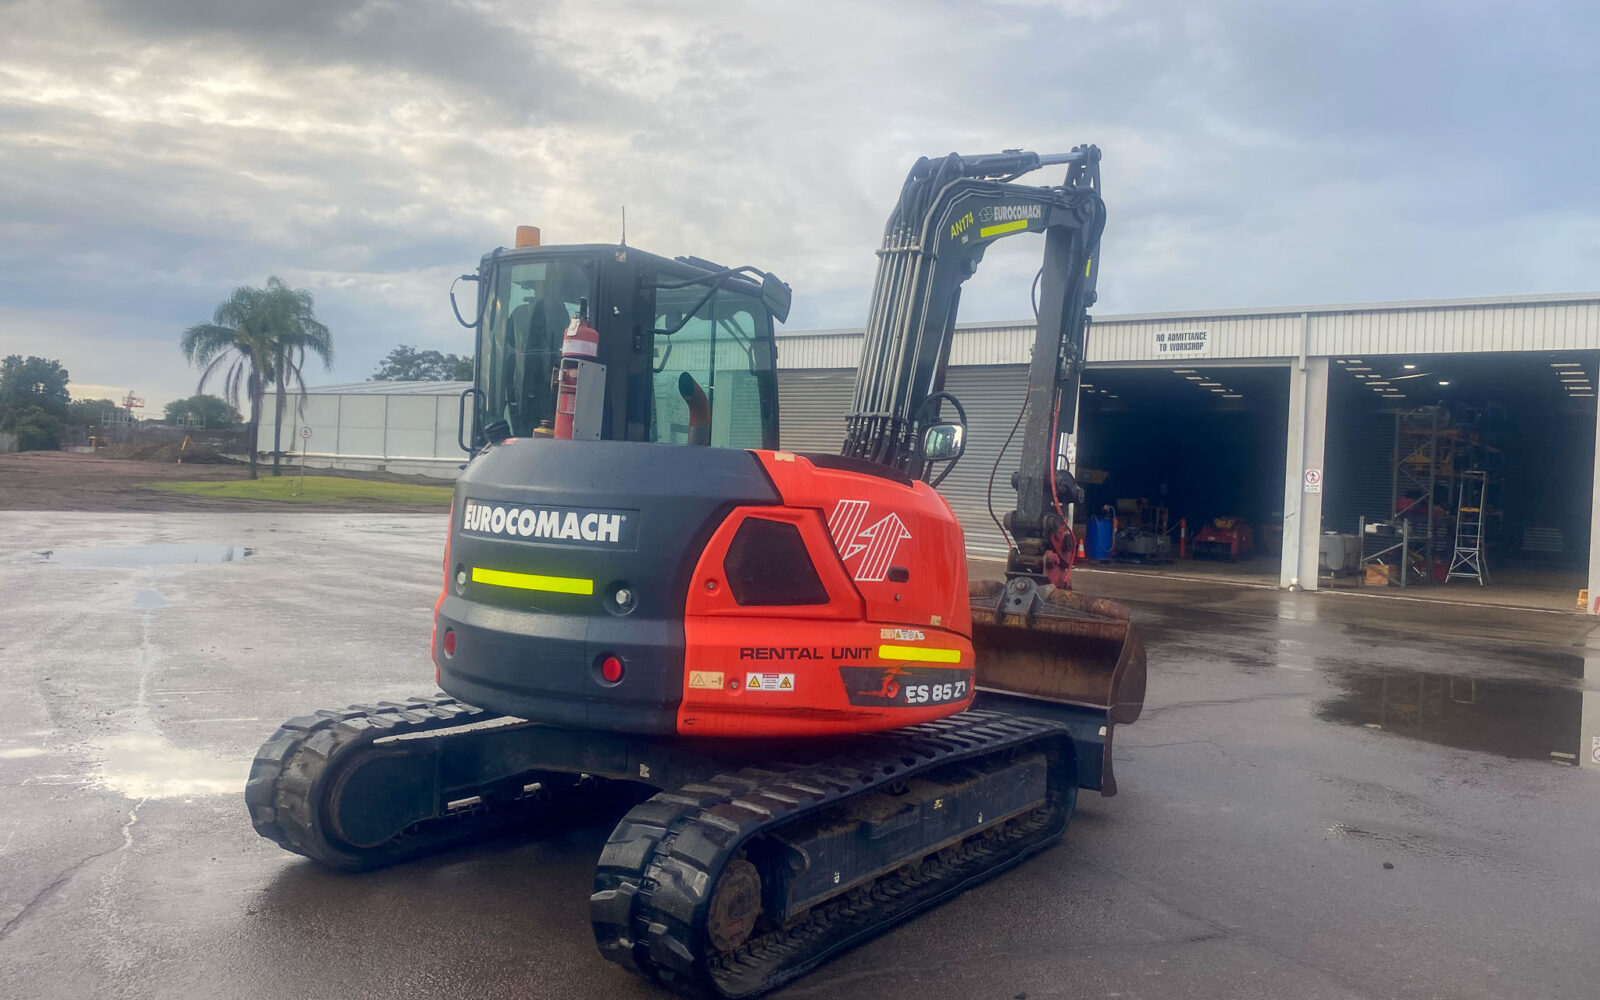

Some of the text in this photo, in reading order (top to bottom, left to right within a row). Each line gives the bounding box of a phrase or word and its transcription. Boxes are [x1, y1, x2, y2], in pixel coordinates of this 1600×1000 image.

[993, 205, 1041, 220] EUROCOMACH
[1156, 332, 1206, 342] NO ADMITTANCE
[1159, 342, 1204, 352] TO WORKSHOP
[740, 647, 873, 660] RENTAL UNIT
[905, 684, 929, 703] ES
[932, 683, 952, 701] 85
